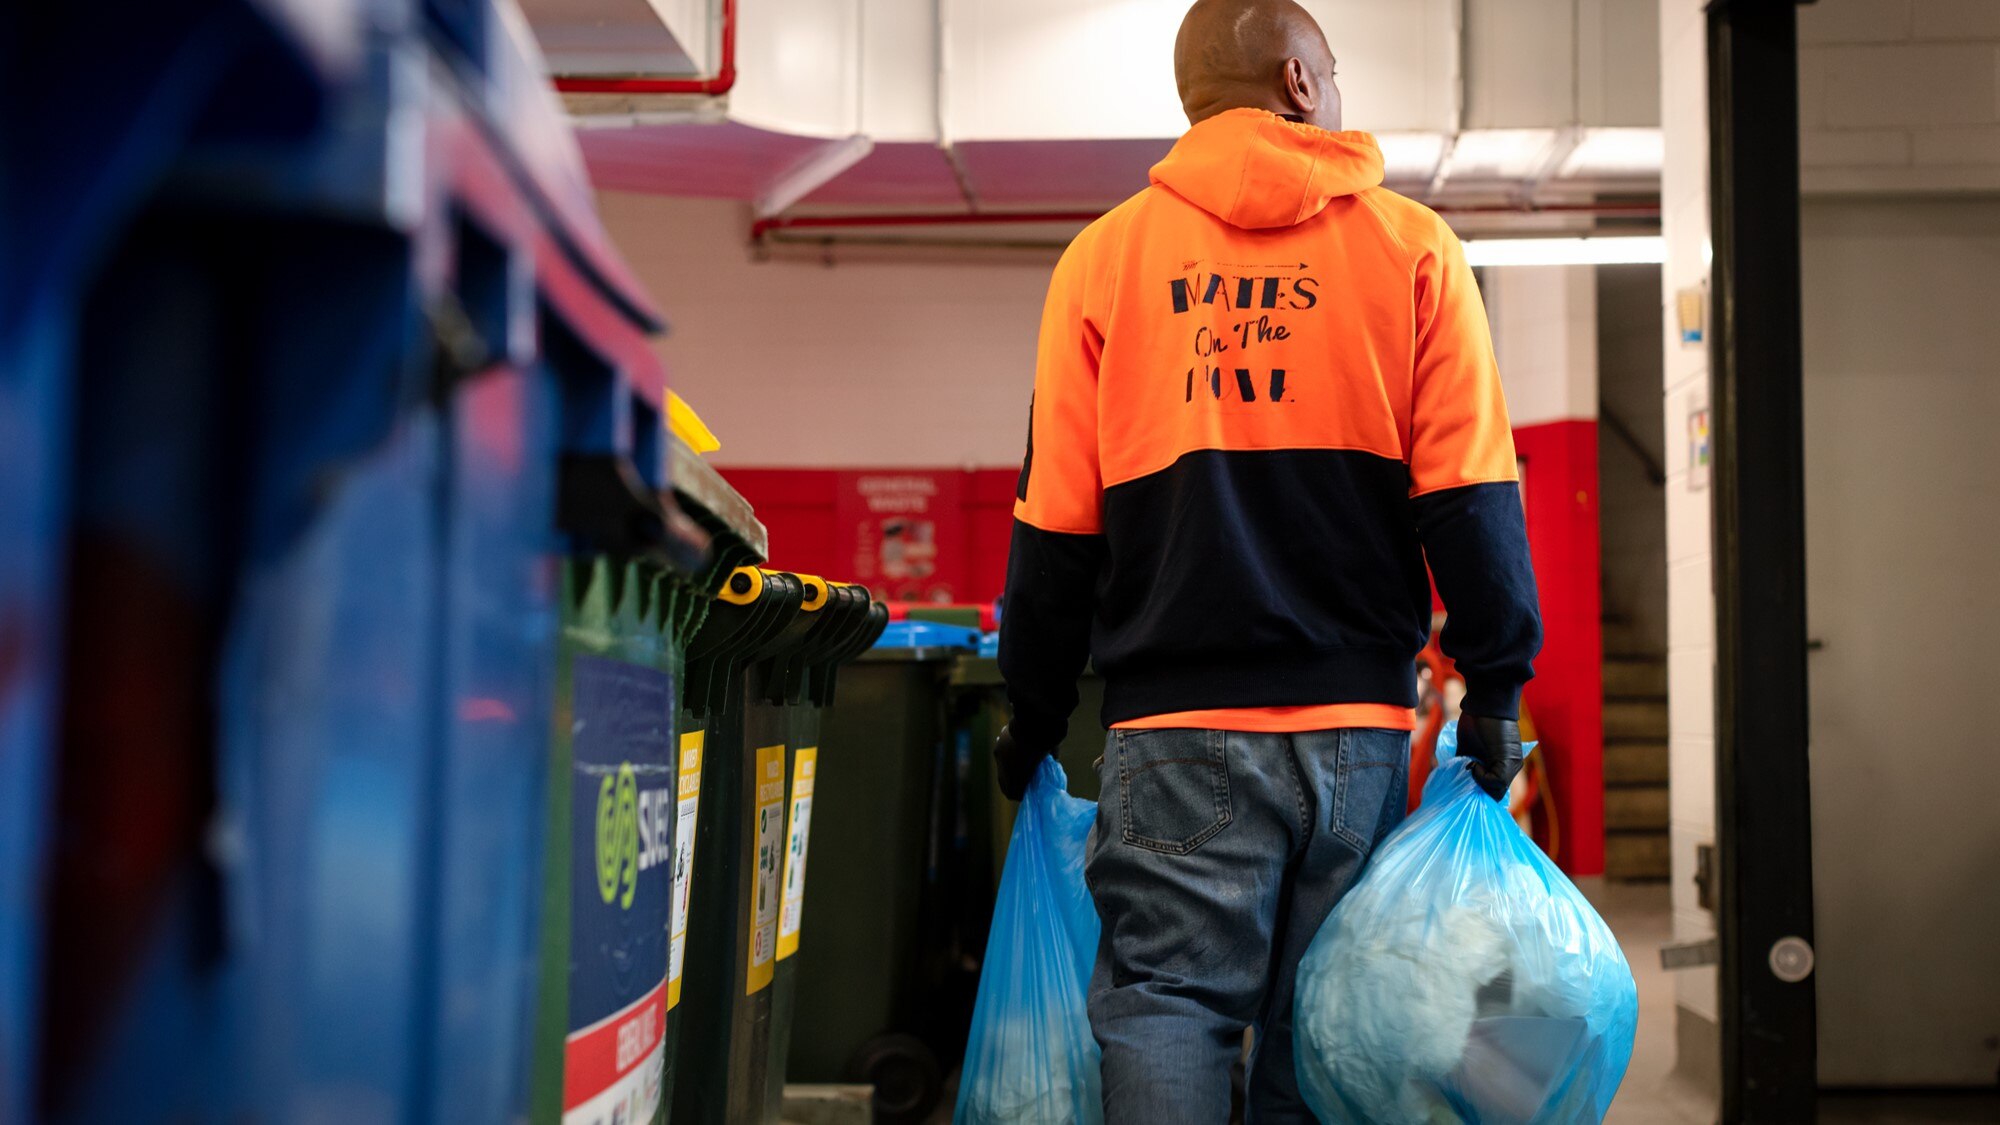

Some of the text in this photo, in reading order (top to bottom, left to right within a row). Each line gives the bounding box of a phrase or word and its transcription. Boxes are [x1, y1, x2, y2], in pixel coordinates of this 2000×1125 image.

[1168, 273, 1319, 314] MATES
[1195, 315, 1291, 357] On The
